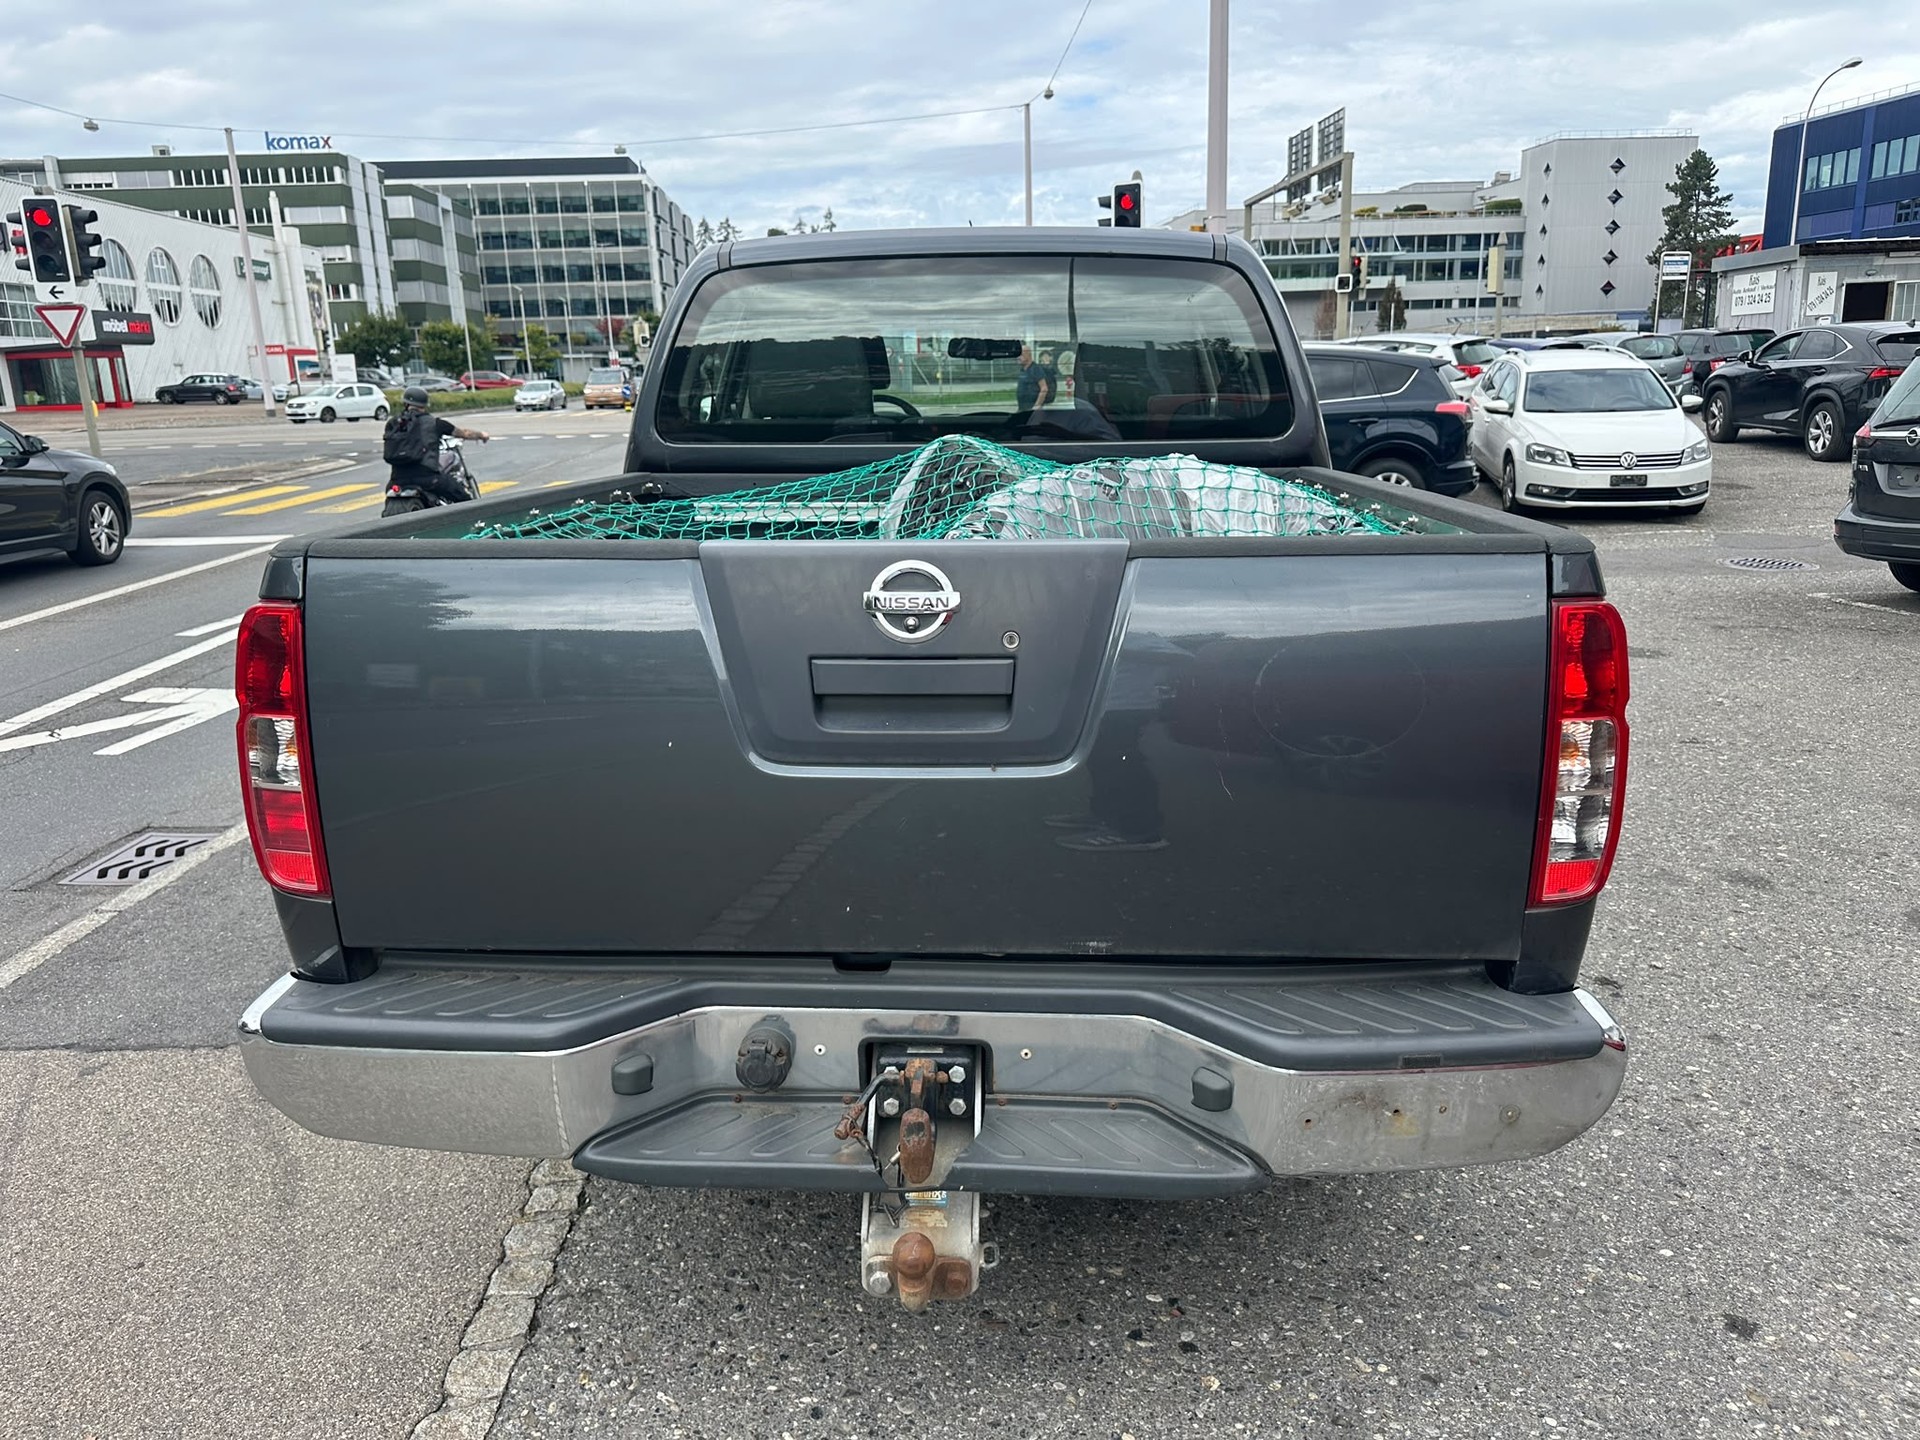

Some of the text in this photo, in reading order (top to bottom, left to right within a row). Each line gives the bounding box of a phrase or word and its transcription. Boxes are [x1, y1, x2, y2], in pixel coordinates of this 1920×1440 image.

[265, 131, 332, 150] komax
[1747, 294, 1756, 305] 324
[1757, 293, 1763, 304] 24
[1764, 292, 1771, 303] 25
[102, 318, 128, 333] möbel
[873, 596, 949, 609] NISSAN
